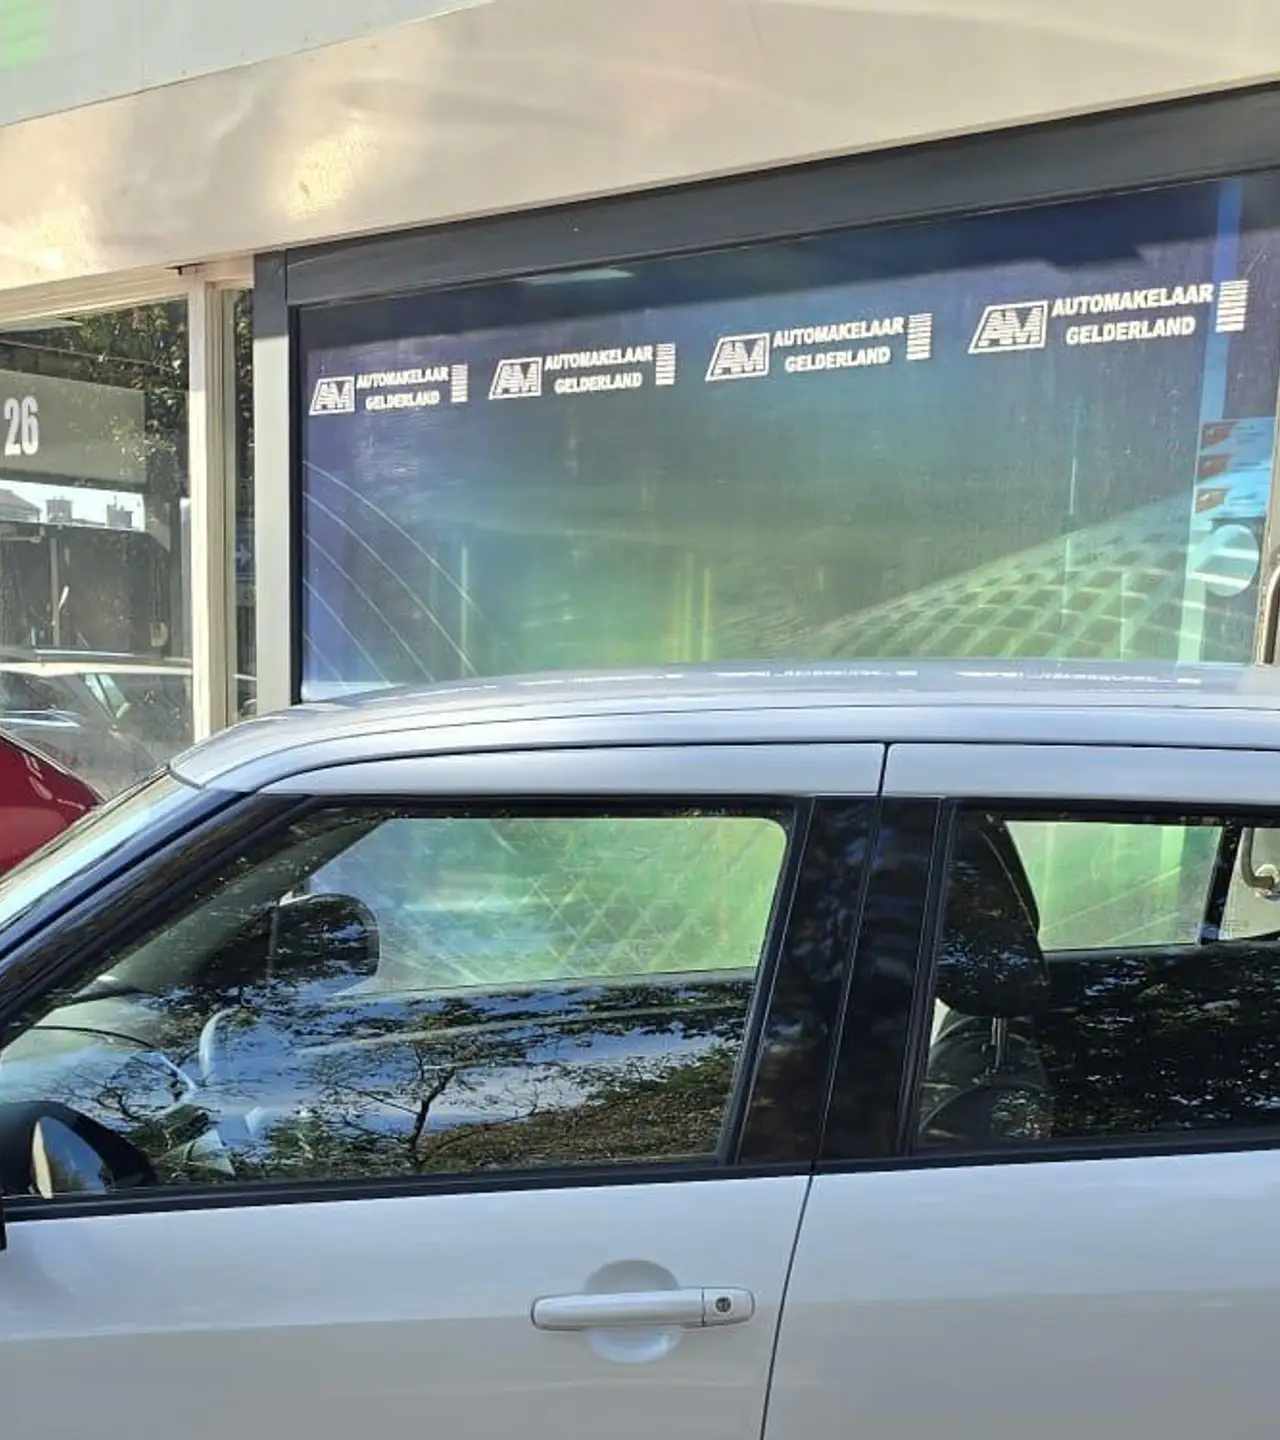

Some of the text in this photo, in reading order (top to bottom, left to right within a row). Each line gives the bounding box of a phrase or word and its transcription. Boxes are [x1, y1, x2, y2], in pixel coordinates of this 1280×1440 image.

[1051, 283, 1215, 317] AUTOMAKELAAR
[773, 316, 906, 348] AUTOMAKELAAR
[1065, 316, 1197, 345] GELDERLAND
[544, 345, 654, 371] AUTOMAKELAAR
[785, 346, 891, 373] GELDERLAND
[356, 366, 449, 389] AUTOMAKELAAR
[554, 372, 643, 395] GELDERLAND
[365, 390, 440, 411] GELDERLAND
[4, 395, 40, 456] 26
